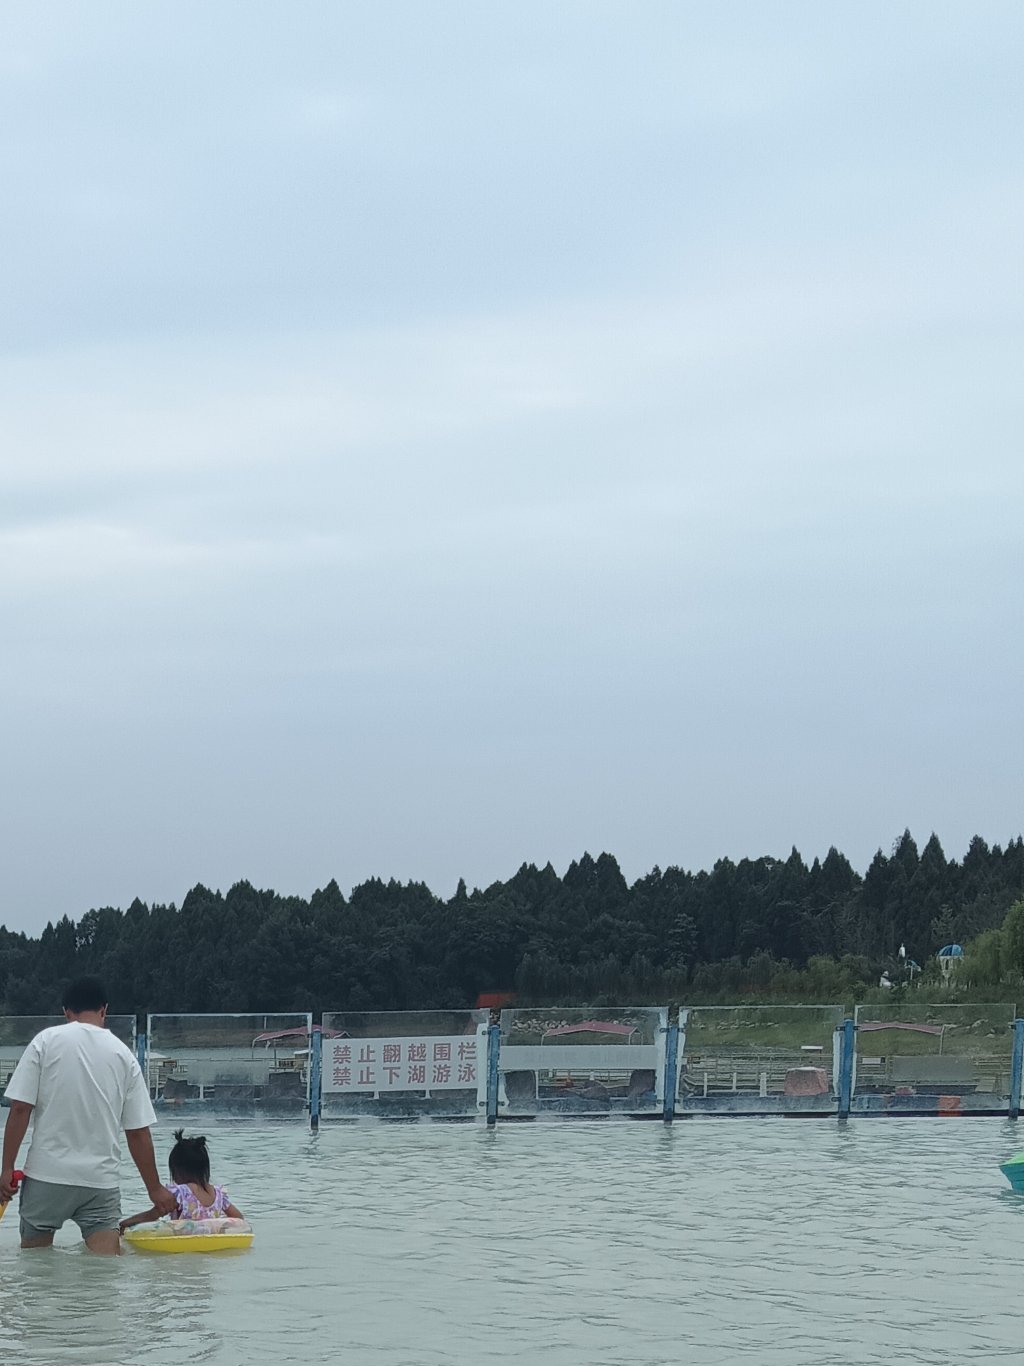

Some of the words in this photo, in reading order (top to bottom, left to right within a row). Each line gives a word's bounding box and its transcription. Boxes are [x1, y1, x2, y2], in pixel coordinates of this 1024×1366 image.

[332, 1042, 477, 1065] 禁止翻越围栏
[332, 1063, 477, 1086] 禁止下湖游泳
